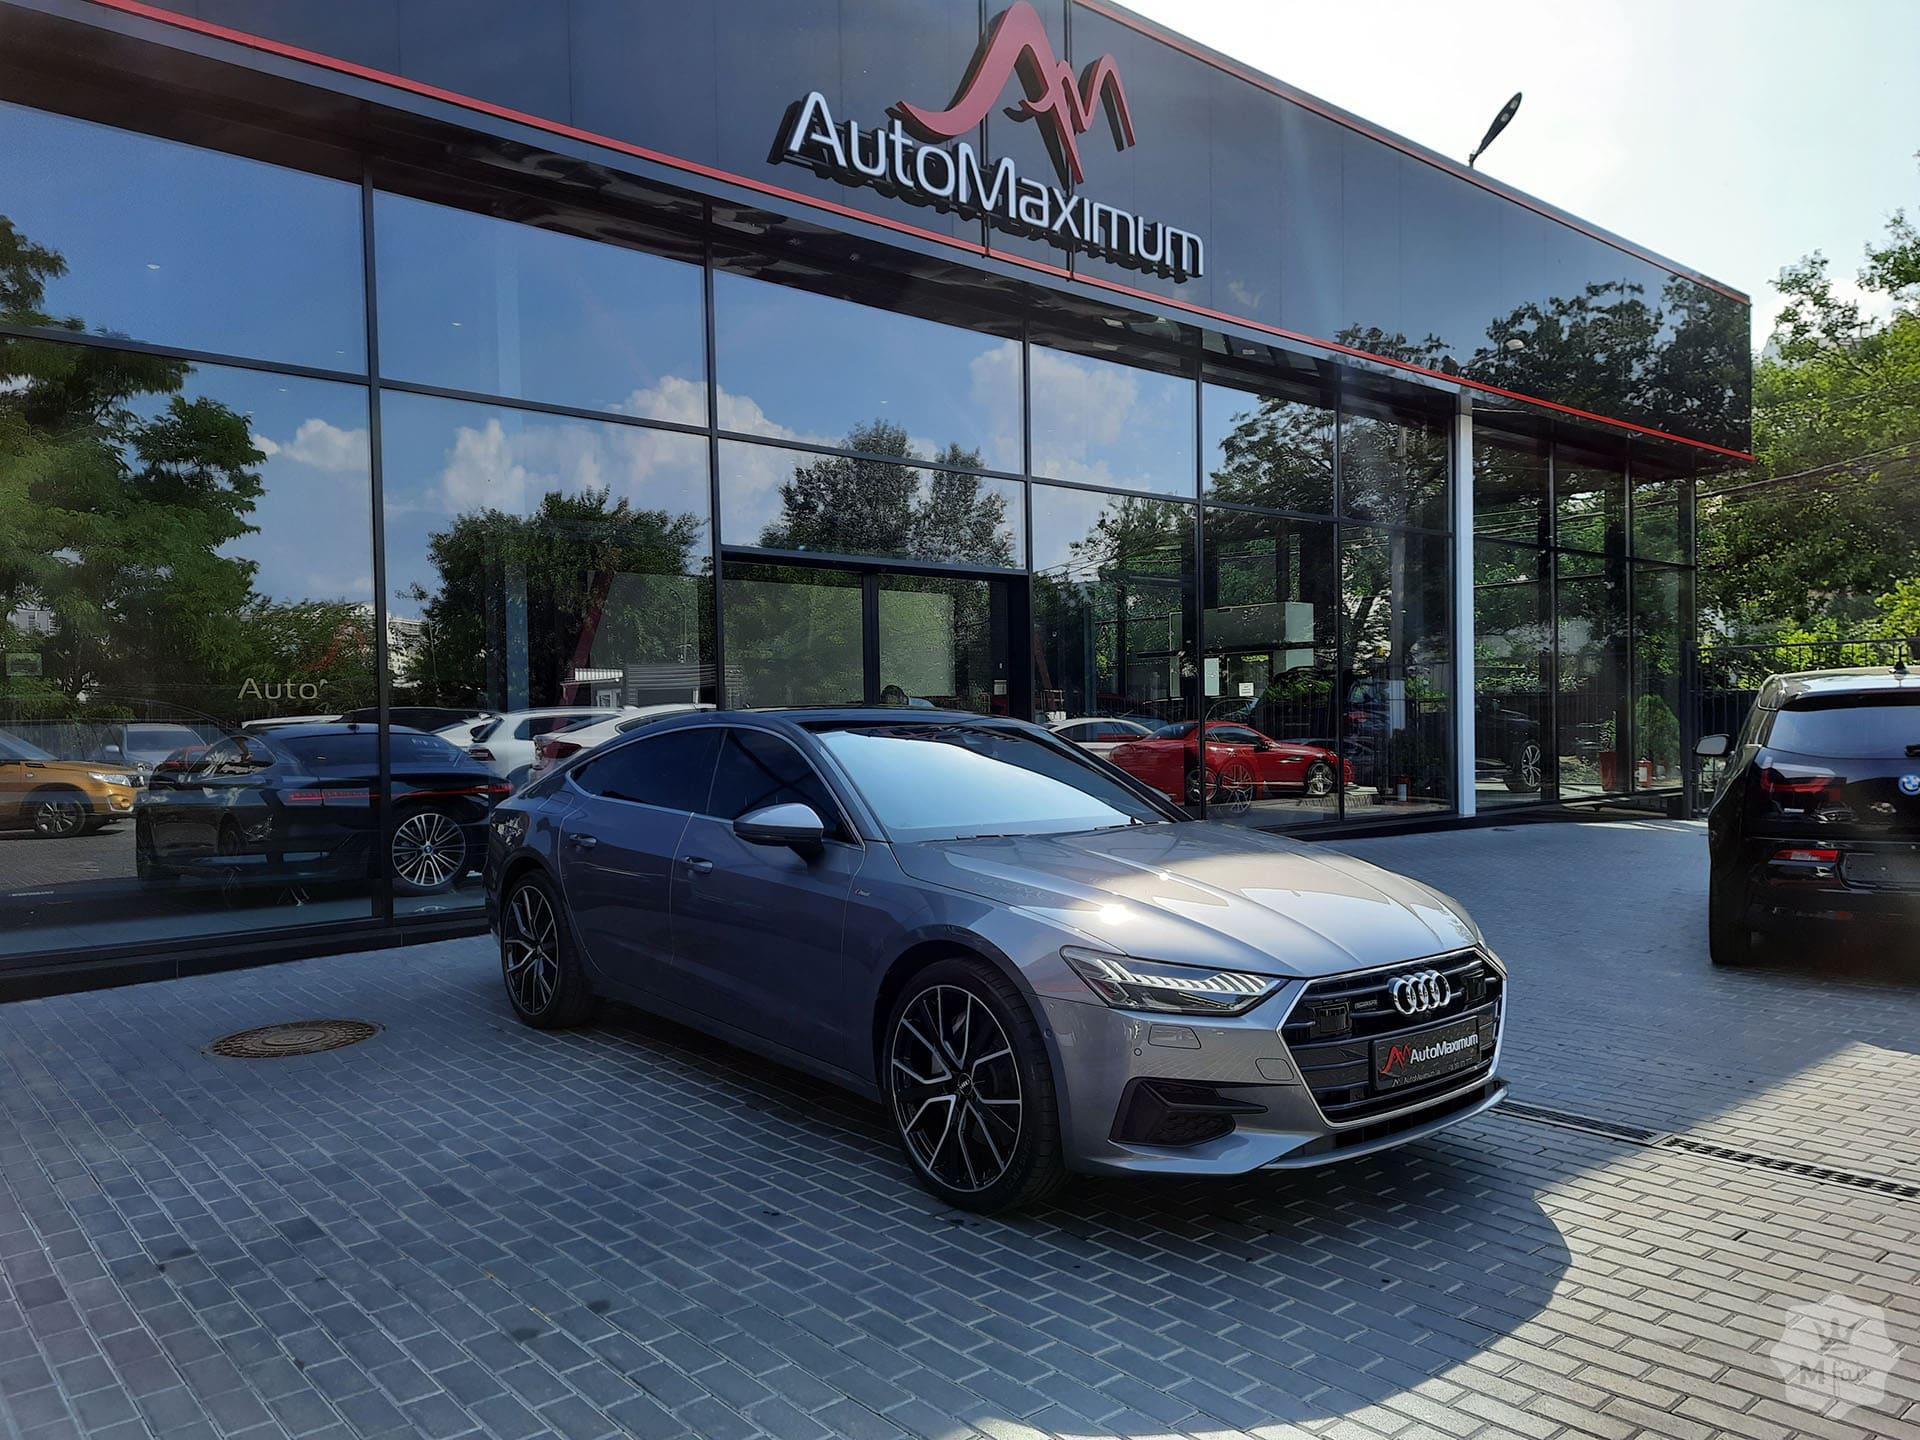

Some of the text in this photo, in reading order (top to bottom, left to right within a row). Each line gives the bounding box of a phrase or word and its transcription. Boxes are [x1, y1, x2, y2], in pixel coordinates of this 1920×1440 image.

[788, 90, 1205, 278] AutoMaximum
[237, 677, 328, 701] Auto
[1410, 1033, 1479, 1065] AutoMaximum
